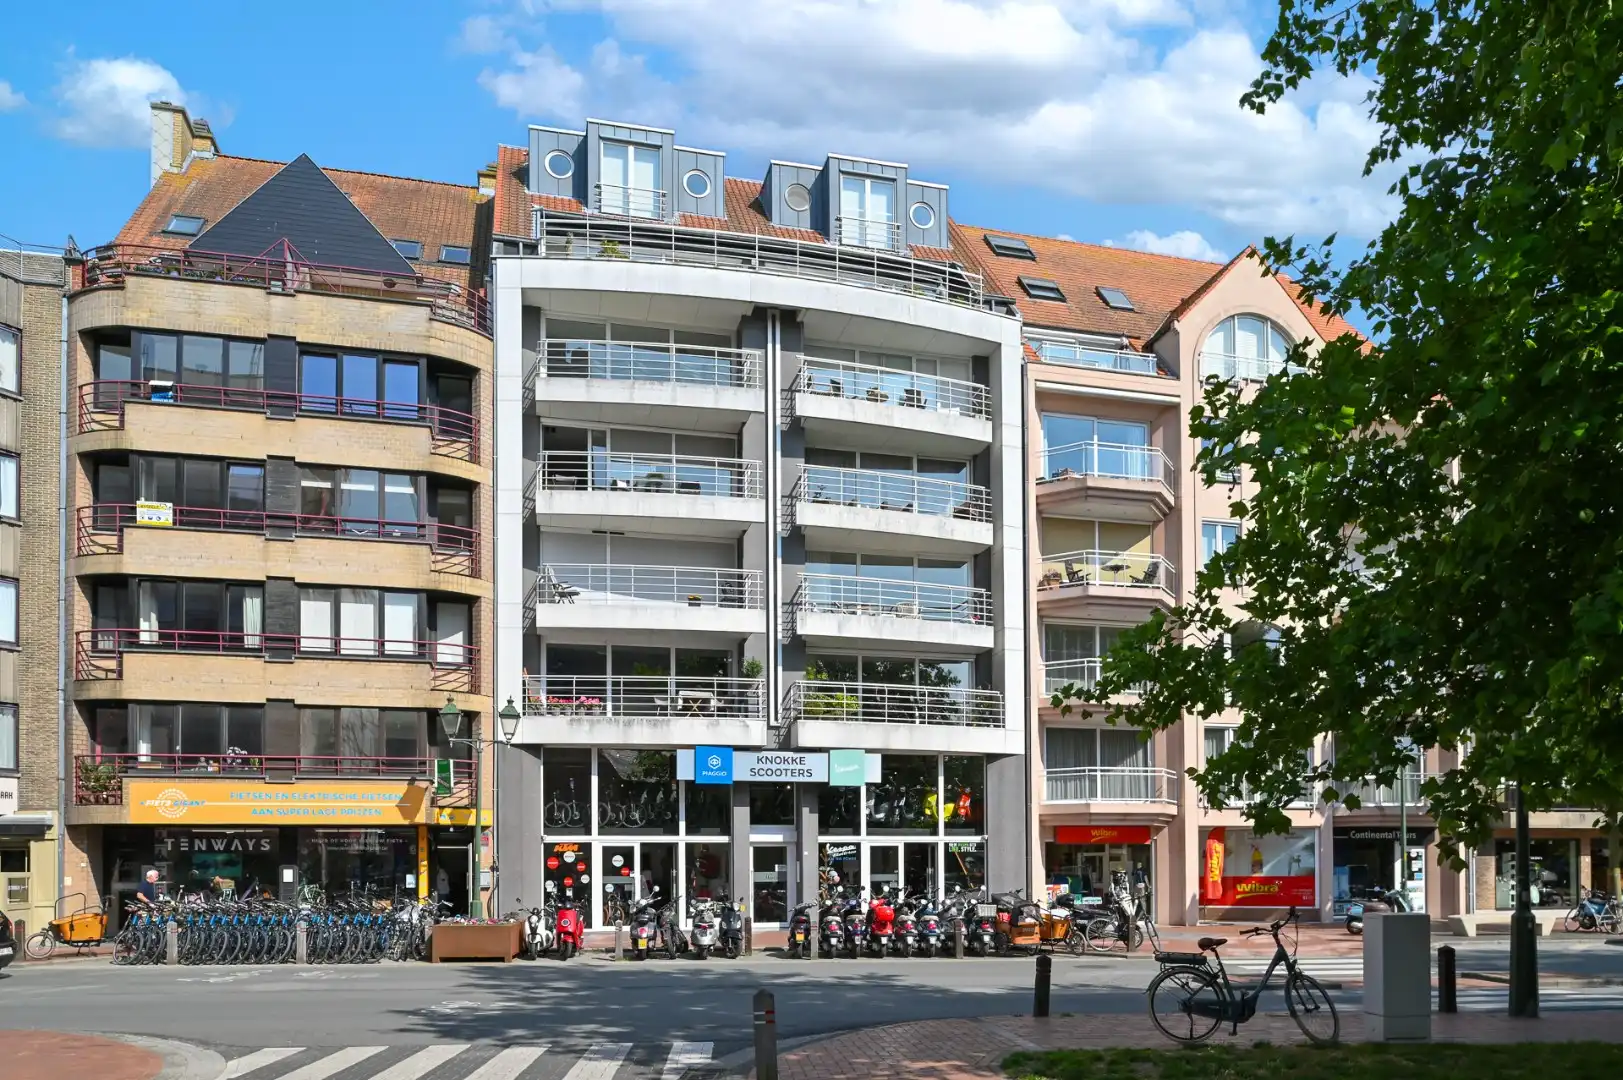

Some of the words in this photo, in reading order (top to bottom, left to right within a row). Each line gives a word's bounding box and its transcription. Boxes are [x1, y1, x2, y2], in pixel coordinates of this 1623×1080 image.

[756, 755, 806, 766] KNOKKE
[749, 767, 813, 778] SCOOTERS
[230, 792, 272, 800] FIETSEN
[291, 793, 358, 801] ELEKTRISCHE
[251, 807, 274, 815] AAN
[1350, 830, 1395, 839] Continental
[164, 838, 271, 851] TENWAYS
